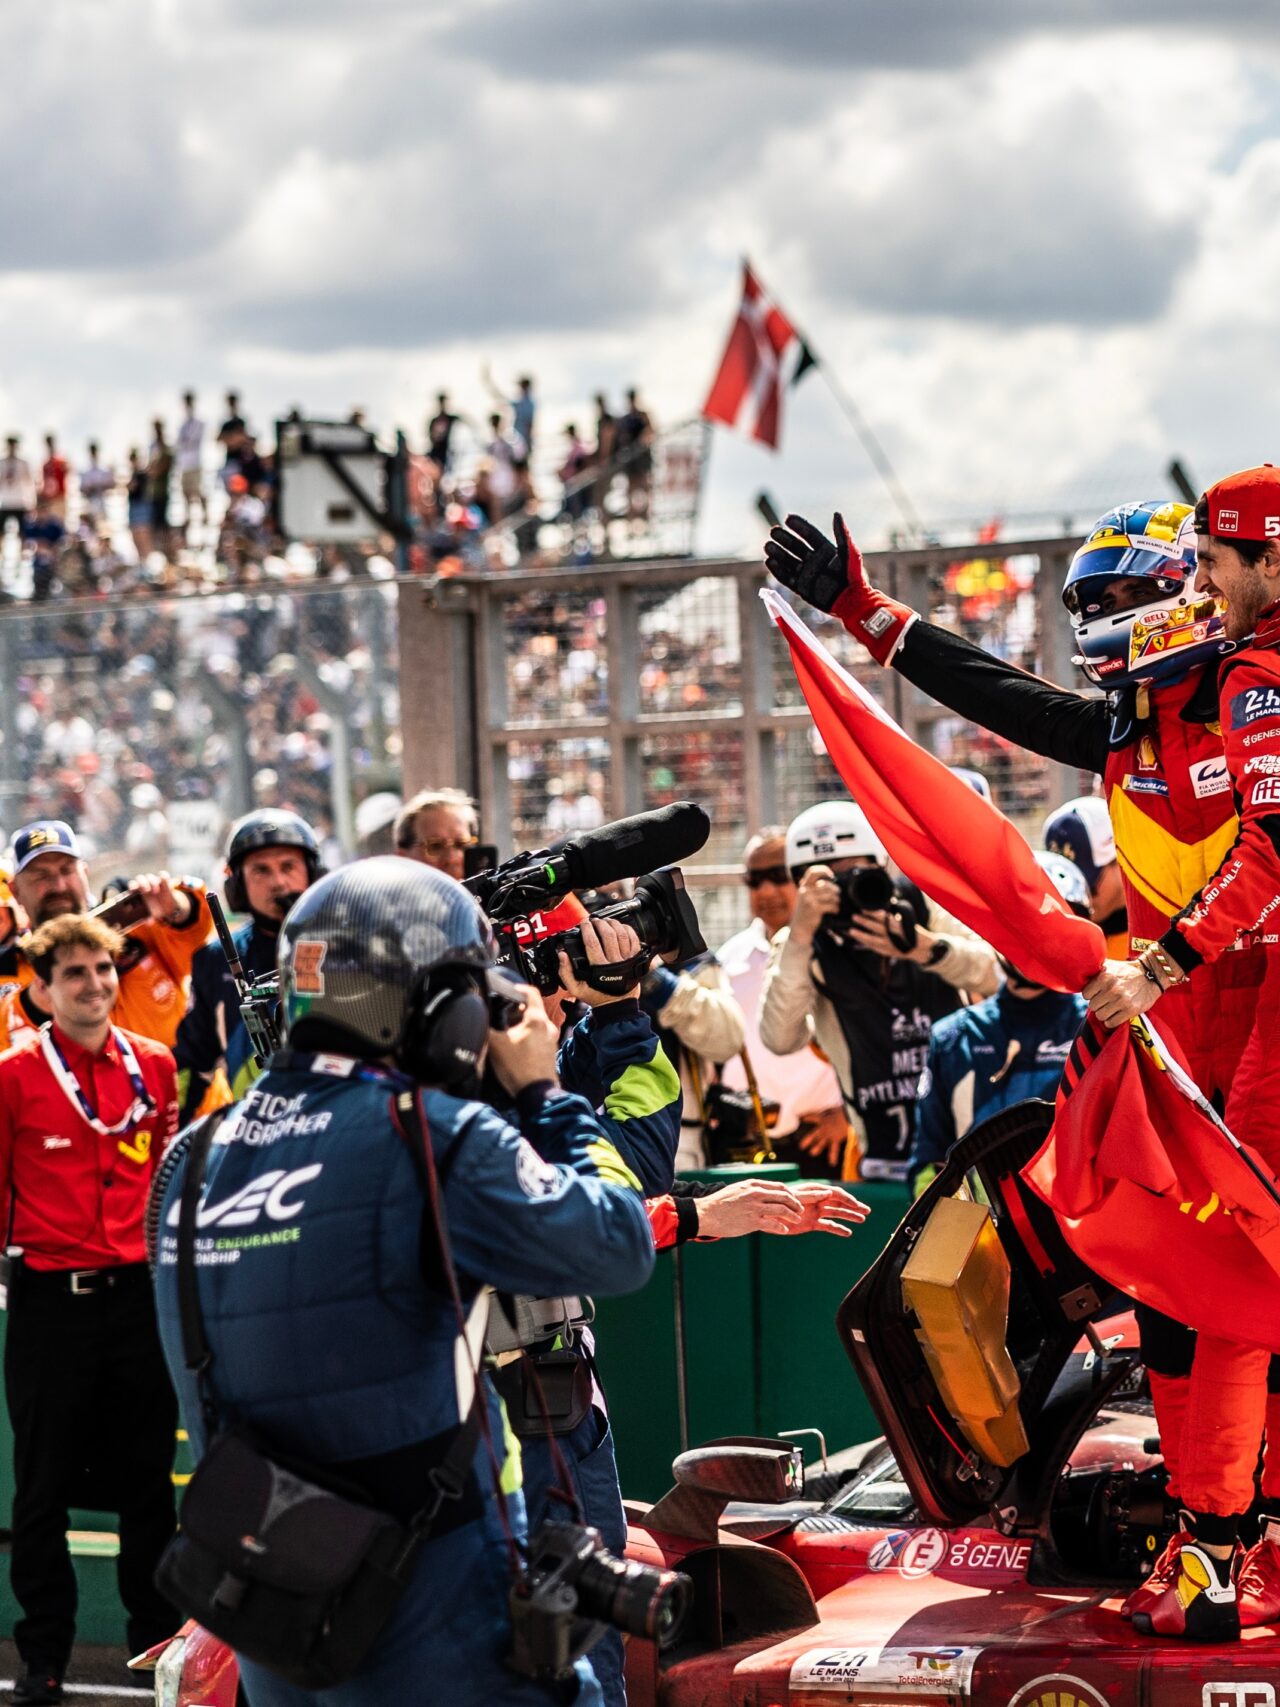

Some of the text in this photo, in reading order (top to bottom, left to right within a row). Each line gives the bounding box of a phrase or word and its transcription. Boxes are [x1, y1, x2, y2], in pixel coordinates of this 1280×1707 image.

[1143, 612, 1166, 623] BELL
[1245, 689, 1280, 713] 24h
[1246, 708, 1280, 722] LE MANS
[1219, 859, 1243, 889] MILLE
[513, 912, 548, 938] 51
[492, 953, 511, 966] NY
[215, 1227, 301, 1249] ENDURANCE
[160, 1250, 241, 1266] CHAONSHIP
[910, 1543, 934, 1569] E
[968, 1545, 1031, 1569] GENE
[810, 1668, 860, 1677] LE MANS
[898, 1675, 953, 1687] TotalEnergies
